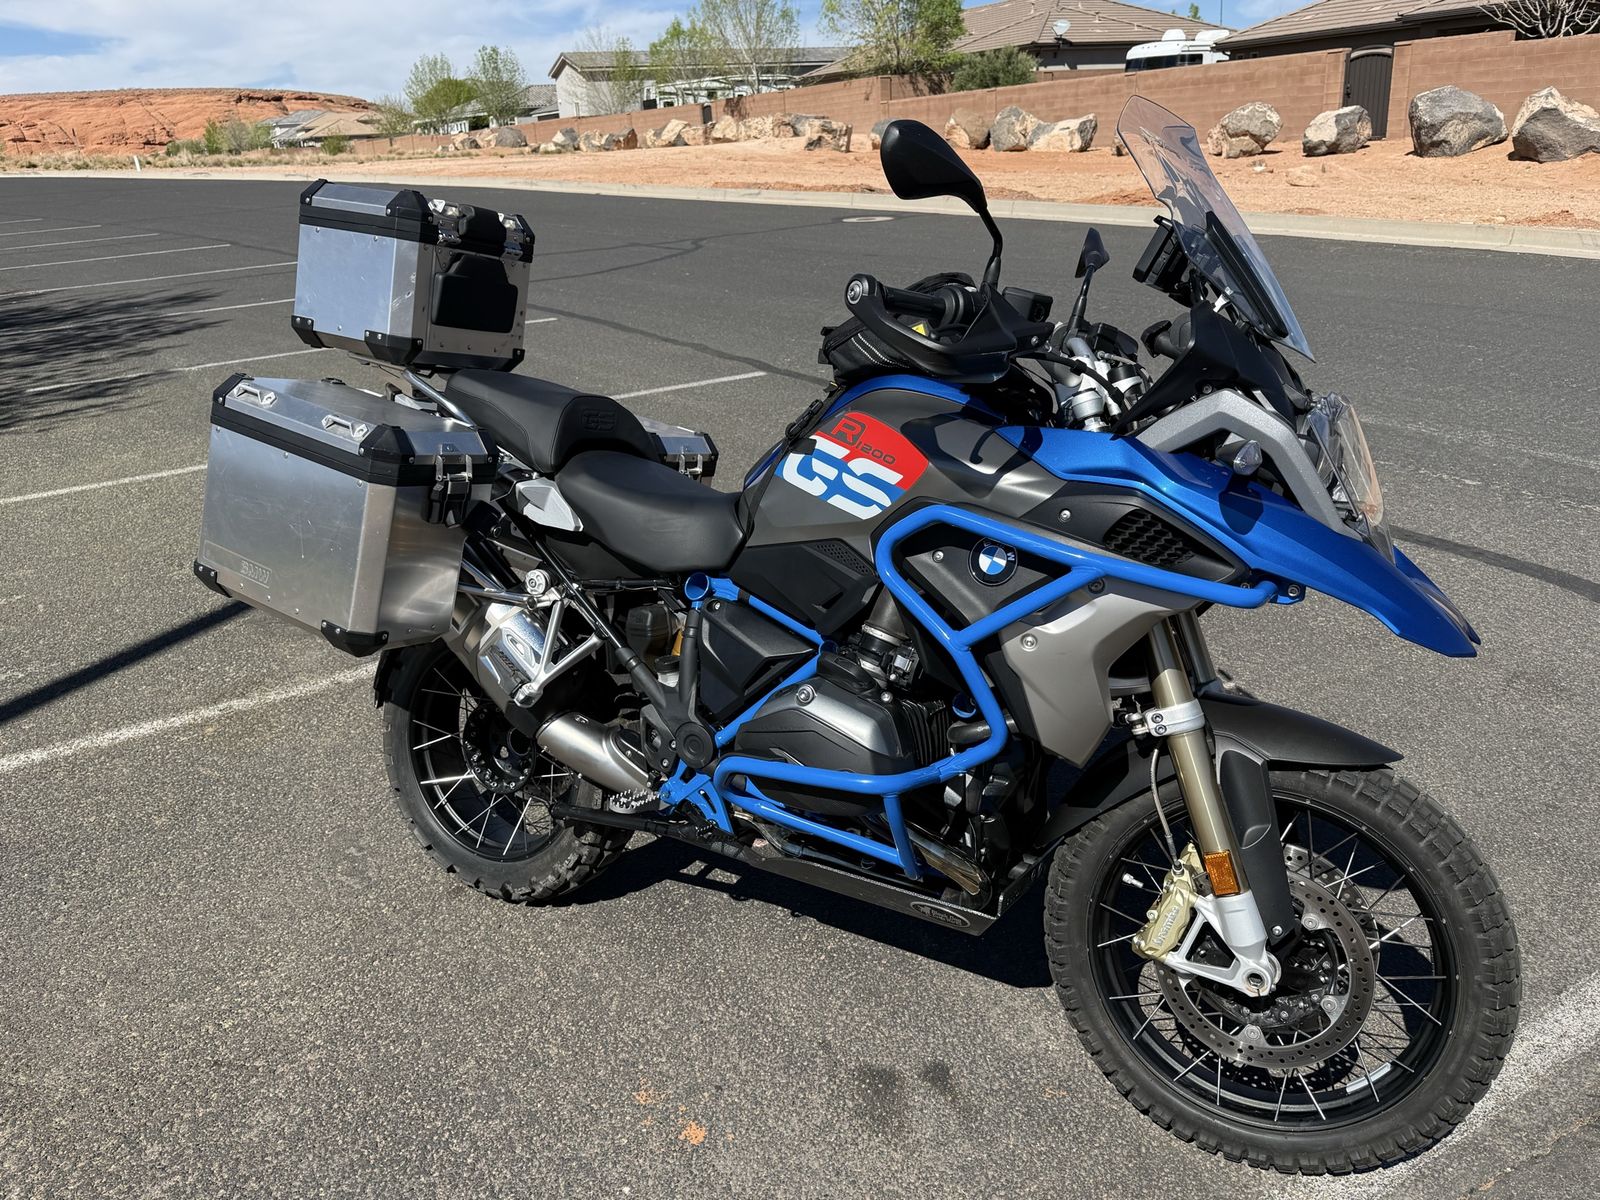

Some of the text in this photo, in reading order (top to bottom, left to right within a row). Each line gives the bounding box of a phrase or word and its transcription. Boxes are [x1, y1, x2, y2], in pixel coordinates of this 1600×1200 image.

[831, 418, 896, 465] R 1200
[783, 435, 903, 520] GS
